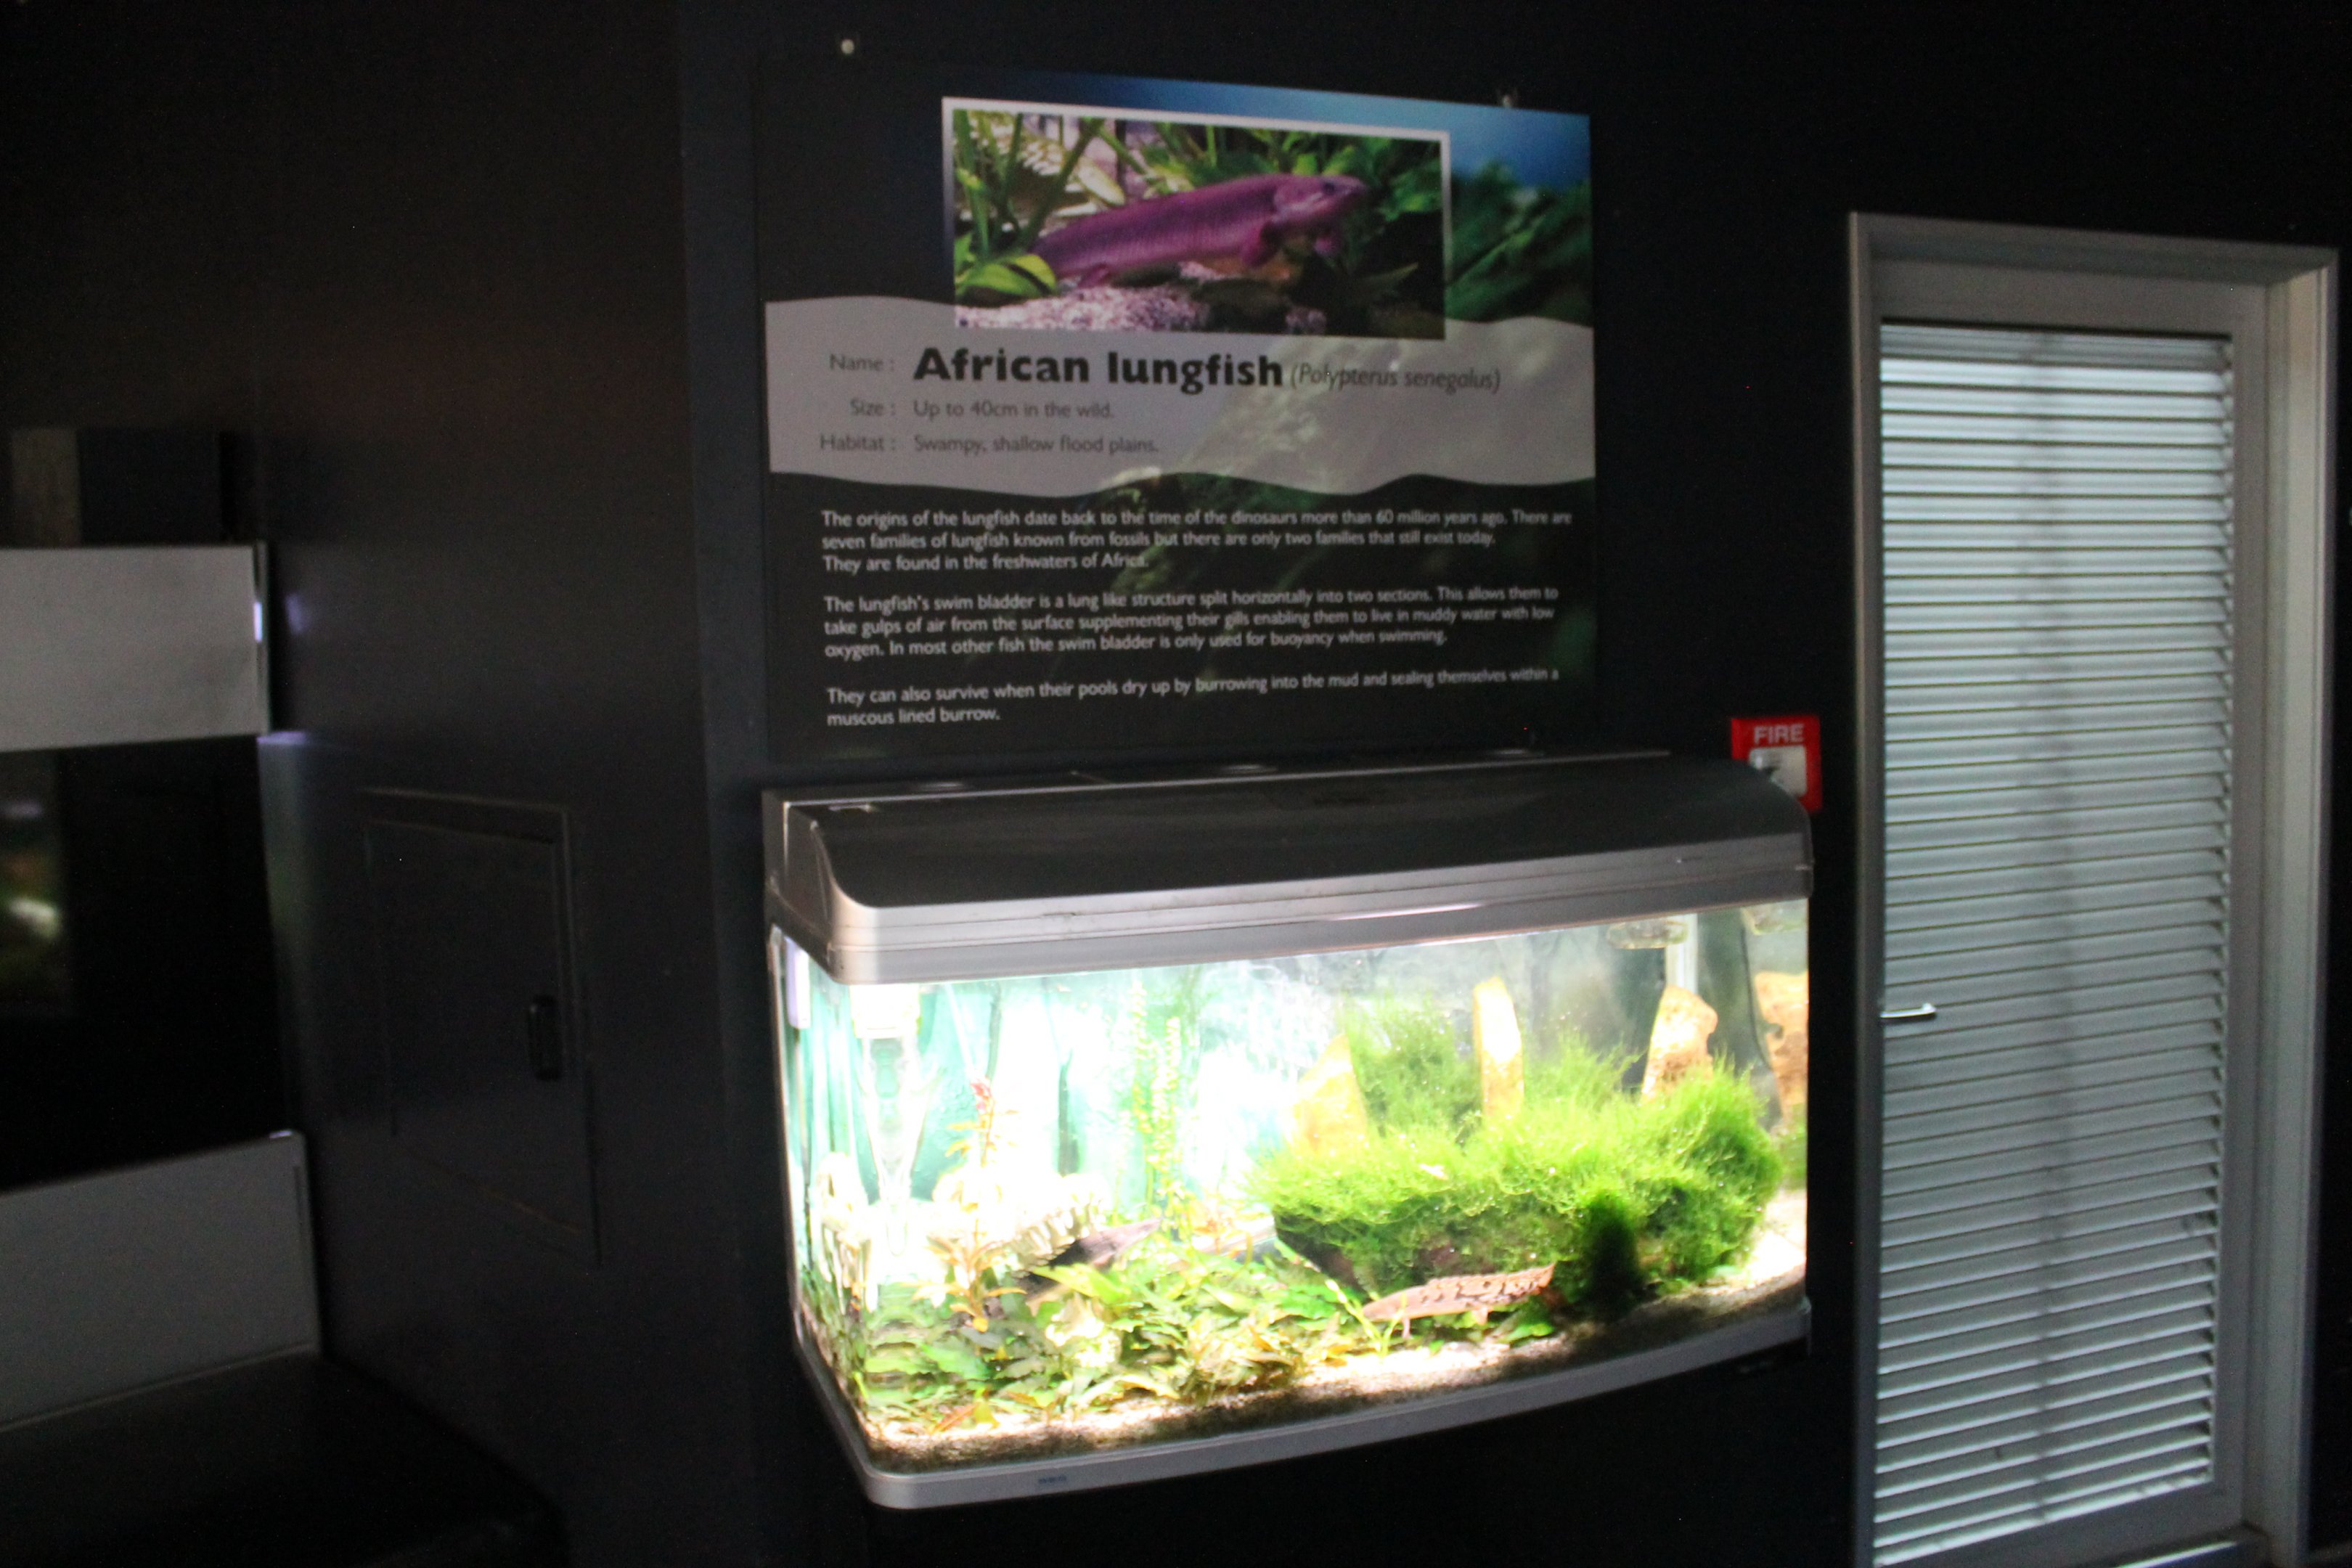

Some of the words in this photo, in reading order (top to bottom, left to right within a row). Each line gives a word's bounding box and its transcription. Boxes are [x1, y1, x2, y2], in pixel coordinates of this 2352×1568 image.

[830, 354, 883, 372] Name
[913, 348, 1088, 381] African
[1108, 352, 1282, 395] lungfish
[850, 399, 883, 416] Size
[914, 401, 940, 421] Up
[947, 404, 964, 416] to
[970, 401, 1016, 417] 40cm
[1024, 402, 1038, 417] in
[1045, 400, 1071, 417] the
[1077, 402, 1114, 418] wild.
[820, 436, 883, 450] Habitat
[915, 436, 986, 456] Swampy,
[993, 436, 1053, 452] shallow
[1060, 436, 1103, 453] flood
[1109, 438, 1158, 456] plains.
[822, 510, 852, 526] The
[856, 512, 907, 531] origins
[913, 510, 931, 526] of
[934, 511, 957, 526] the
[963, 510, 1019, 530] lungfish
[1025, 511, 1057, 525] date
[1061, 511, 1095, 525] back
[1101, 513, 1116, 525] to
[1122, 511, 1144, 525] the
[1149, 511, 1180, 525] time
[1185, 510, 1201, 524] of
[1204, 510, 1227, 524] the
[1232, 510, 1297, 524] dinosaurs
[1302, 513, 1337, 524] more
[1343, 510, 1371, 523] than
[1397, 510, 1440, 523] million
[1444, 513, 1477, 528] years
[1512, 509, 1548, 523] There
[1553, 513, 1572, 523] are
[822, 536, 865, 549] seven
[931, 532, 949, 548] of
[952, 533, 1008, 552] lungfish
[1013, 533, 1063, 546] known
[1069, 531, 1105, 546] from
[1109, 531, 1149, 545] fossils
[1154, 531, 1178, 545] but
[1183, 531, 1220, 544] there
[1226, 533, 1247, 544] are
[1251, 531, 1281, 549] only
[1286, 533, 1312, 544] two
[1368, 531, 1395, 544] that
[824, 556, 861, 575] They
[867, 558, 891, 571] are
[897, 555, 940, 571] found
[945, 555, 959, 569] in
[964, 555, 987, 569] the
[993, 553, 1077, 568] freshwaters
[1082, 553, 1098, 568] of
[824, 596, 854, 612] The
[859, 595, 929, 616] lungfish's
[934, 596, 973, 610] swim
[979, 594, 1034, 609] bladder
[1040, 594, 1050, 608] is
[1055, 596, 1063, 608] a
[1068, 592, 1099, 611] lung
[1103, 592, 1126, 607] like
[1132, 594, 1196, 605] structure
[1200, 591, 1227, 608] split
[1232, 589, 1312, 607] horizontally
[1317, 589, 1343, 602] into
[1347, 589, 1373, 602] two
[1438, 586, 1463, 601] This
[1468, 587, 1505, 600] allows
[1509, 587, 1541, 600] them
[1545, 587, 1559, 600] to
[824, 620, 857, 634] take
[862, 618, 901, 638] gulps
[906, 617, 923, 632] of
[927, 618, 945, 632] air
[952, 616, 987, 631] from
[992, 616, 1016, 631] the
[1022, 615, 1074, 630] surface
[1079, 614, 1183, 632] supplementing
[1187, 613, 1220, 626] their
[1254, 612, 1310, 629] enabling
[1314, 611, 1349, 623] them
[1352, 611, 1367, 623] to
[1371, 609, 1392, 622] live
[1397, 609, 1409, 621] in
[1413, 608, 1457, 624] muddy
[1462, 609, 1496, 620] water
[1501, 607, 1528, 619] with
[1532, 607, 1554, 618] low
[825, 645, 884, 661] oxygen.
[890, 641, 904, 655] In
[909, 641, 947, 654] most
[952, 640, 994, 653] other
[999, 637, 1024, 652] fish
[1029, 638, 1053, 651] the
[1058, 637, 1096, 650] swim
[1101, 634, 1156, 649] bladder
[1160, 635, 1170, 648] is
[1175, 634, 1204, 651] only
[1210, 634, 1241, 647] used
[1246, 632, 1265, 646] for
[1270, 632, 1334, 648] buoyancy
[1339, 630, 1374, 643] when
[828, 688, 865, 707] They
[870, 690, 897, 703] can
[902, 687, 931, 701] also
[936, 685, 989, 700] survive
[994, 683, 1034, 698] when
[1040, 682, 1074, 696] their
[1079, 681, 1119, 699] pools
[1122, 679, 1147, 698] dry
[1152, 681, 1170, 697] up
[1175, 678, 1191, 696] by
[1196, 677, 1267, 694] burrowing
[1272, 676, 1299, 688] into
[1303, 674, 1324, 688] the
[1328, 674, 1359, 687] mud
[1363, 672, 1387, 686] and
[1511, 668, 1548, 681] within
[1552, 669, 1559, 680] a
[828, 713, 894, 725] muscous
[899, 707, 936, 723] lined
[940, 707, 1000, 722] burrow.
[1754, 724, 1805, 744] FIRE
